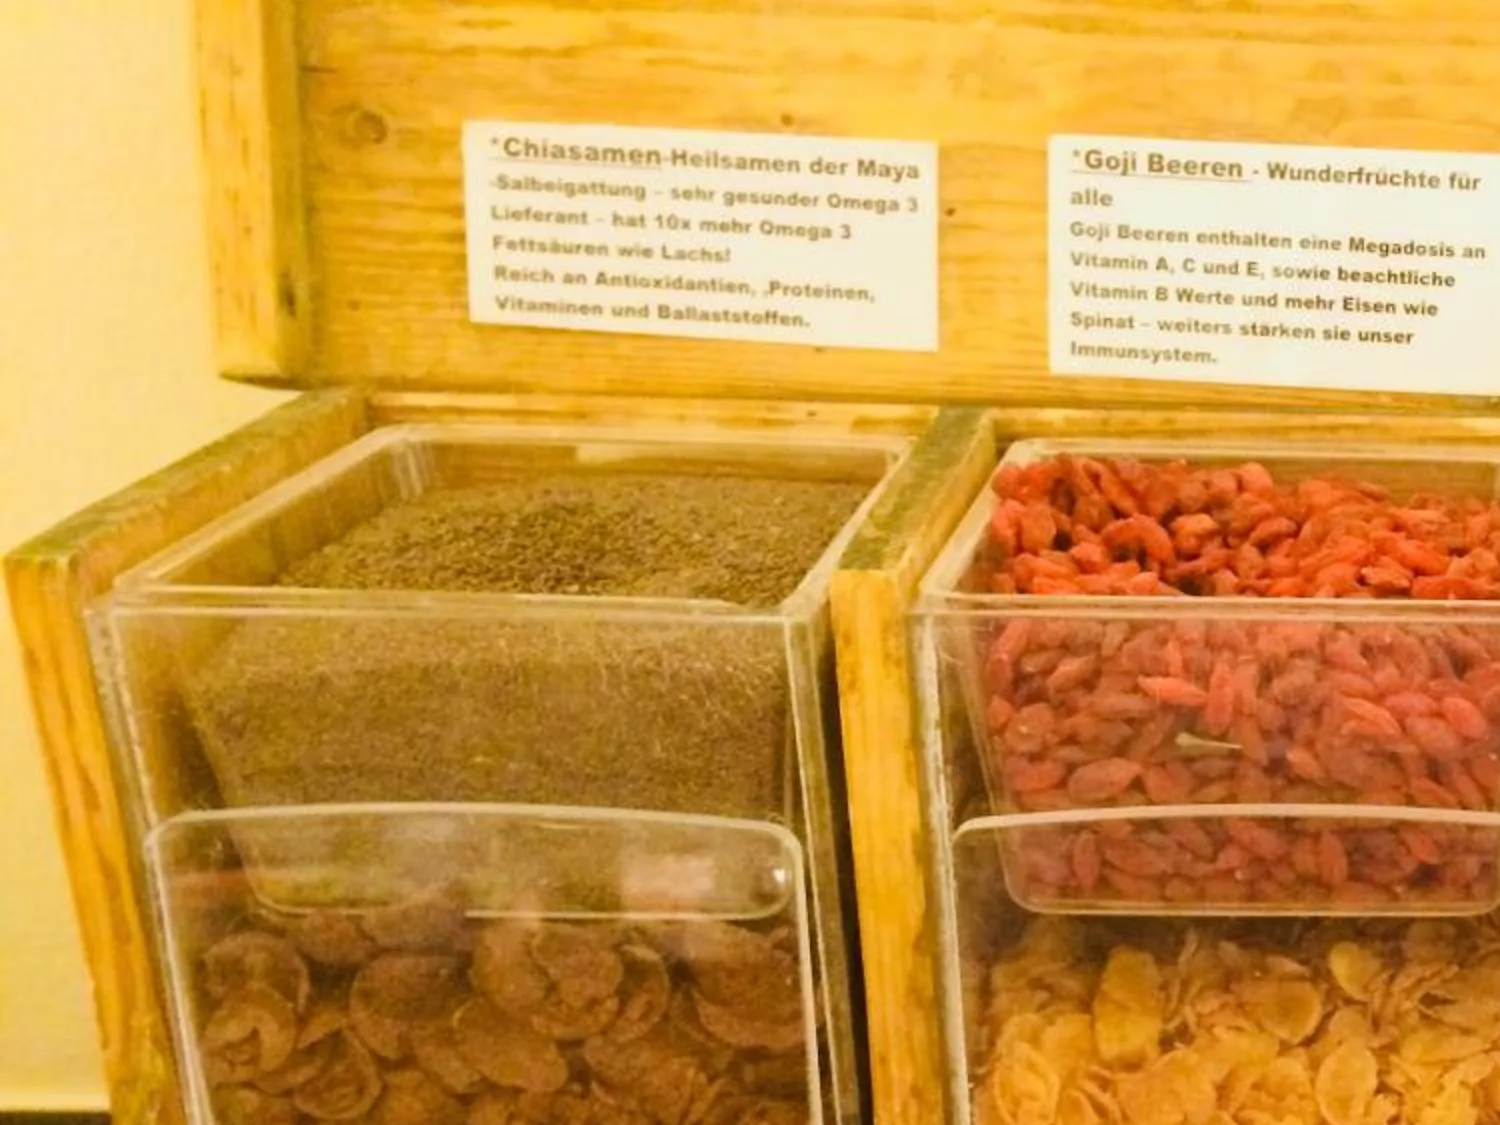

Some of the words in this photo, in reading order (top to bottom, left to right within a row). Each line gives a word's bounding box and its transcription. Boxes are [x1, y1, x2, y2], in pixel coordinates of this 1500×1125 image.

[809, 156, 848, 175] der
[857, 158, 920, 183] Maya
[1147, 153, 1244, 178] Beeren
[1267, 161, 1440, 189] Wunderfrüchte
[1449, 172, 1481, 190] für
[671, 186, 716, 201] sehr
[723, 191, 818, 207] gesunder
[827, 193, 899, 215] Omega
[907, 197, 919, 212] 3
[1070, 188, 1114, 207] alle
[490, 206, 588, 225] Lieferant
[611, 211, 646, 228] hat
[654, 214, 691, 230] 10x
[699, 217, 751, 234] mehr
[759, 220, 832, 241] Omega
[840, 224, 852, 239] 3
[492, 235, 609, 256] Fettsäuren
[618, 243, 654, 258] wie
[661, 245, 731, 262] Lachs!
[1070, 221, 1109, 242] Goji
[1117, 224, 1189, 243] Beeren
[1196, 231, 1292, 249] enthalten
[1300, 236, 1342, 250] eine
[1349, 236, 1455, 258] Megadosis
[1462, 246, 1486, 259] an
[494, 265, 554, 283] Reich
[562, 272, 587, 284] an
[595, 272, 756, 297] Antioxidantien,
[1070, 252, 1148, 271] Vitamin
[1155, 256, 1175, 275] A,
[1182, 258, 1196, 273] C
[1203, 260, 1240, 276] und
[1246, 262, 1265, 280] E,
[1272, 265, 1330, 281] sowie
[1338, 266, 1456, 288] beachtliche
[495, 296, 603, 315] Vitaminen
[611, 304, 649, 318] und
[657, 304, 810, 327] Ballaststoffen.
[1070, 282, 1148, 300] Vitamin
[1155, 287, 1169, 301] B
[1176, 288, 1235, 305] Werte
[1241, 293, 1278, 309] und
[1285, 295, 1335, 311] mehr
[1342, 297, 1396, 314] Eisen
[1403, 301, 1439, 316] wie
[1070, 311, 1135, 331] Spinat
[1157, 319, 1232, 335] weiters
[1323, 326, 1351, 341] sie
[1357, 329, 1415, 344] unser
[1070, 341, 1218, 364] Immunsystem.
